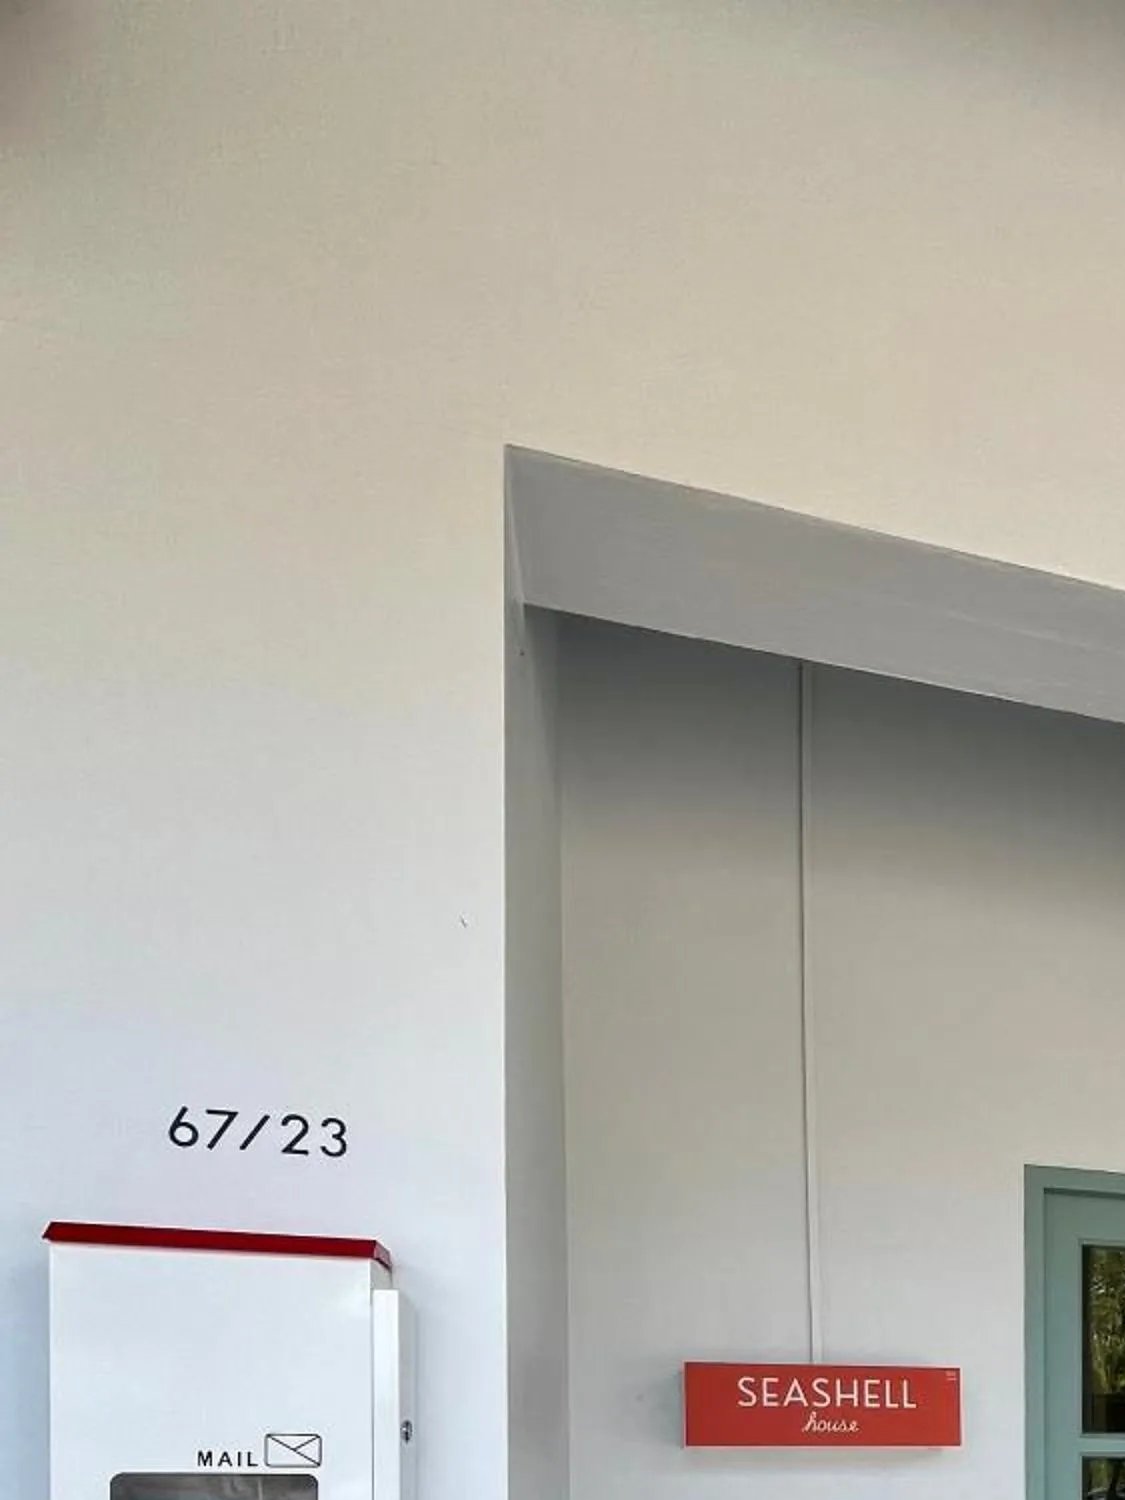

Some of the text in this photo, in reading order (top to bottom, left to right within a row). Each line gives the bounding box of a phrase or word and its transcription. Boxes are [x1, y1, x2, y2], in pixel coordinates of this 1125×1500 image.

[168, 1105, 348, 1158] 67/23
[737, 1376, 917, 1408] SEASHELL
[803, 1411, 860, 1433] house
[197, 1450, 258, 1468] MAIL
